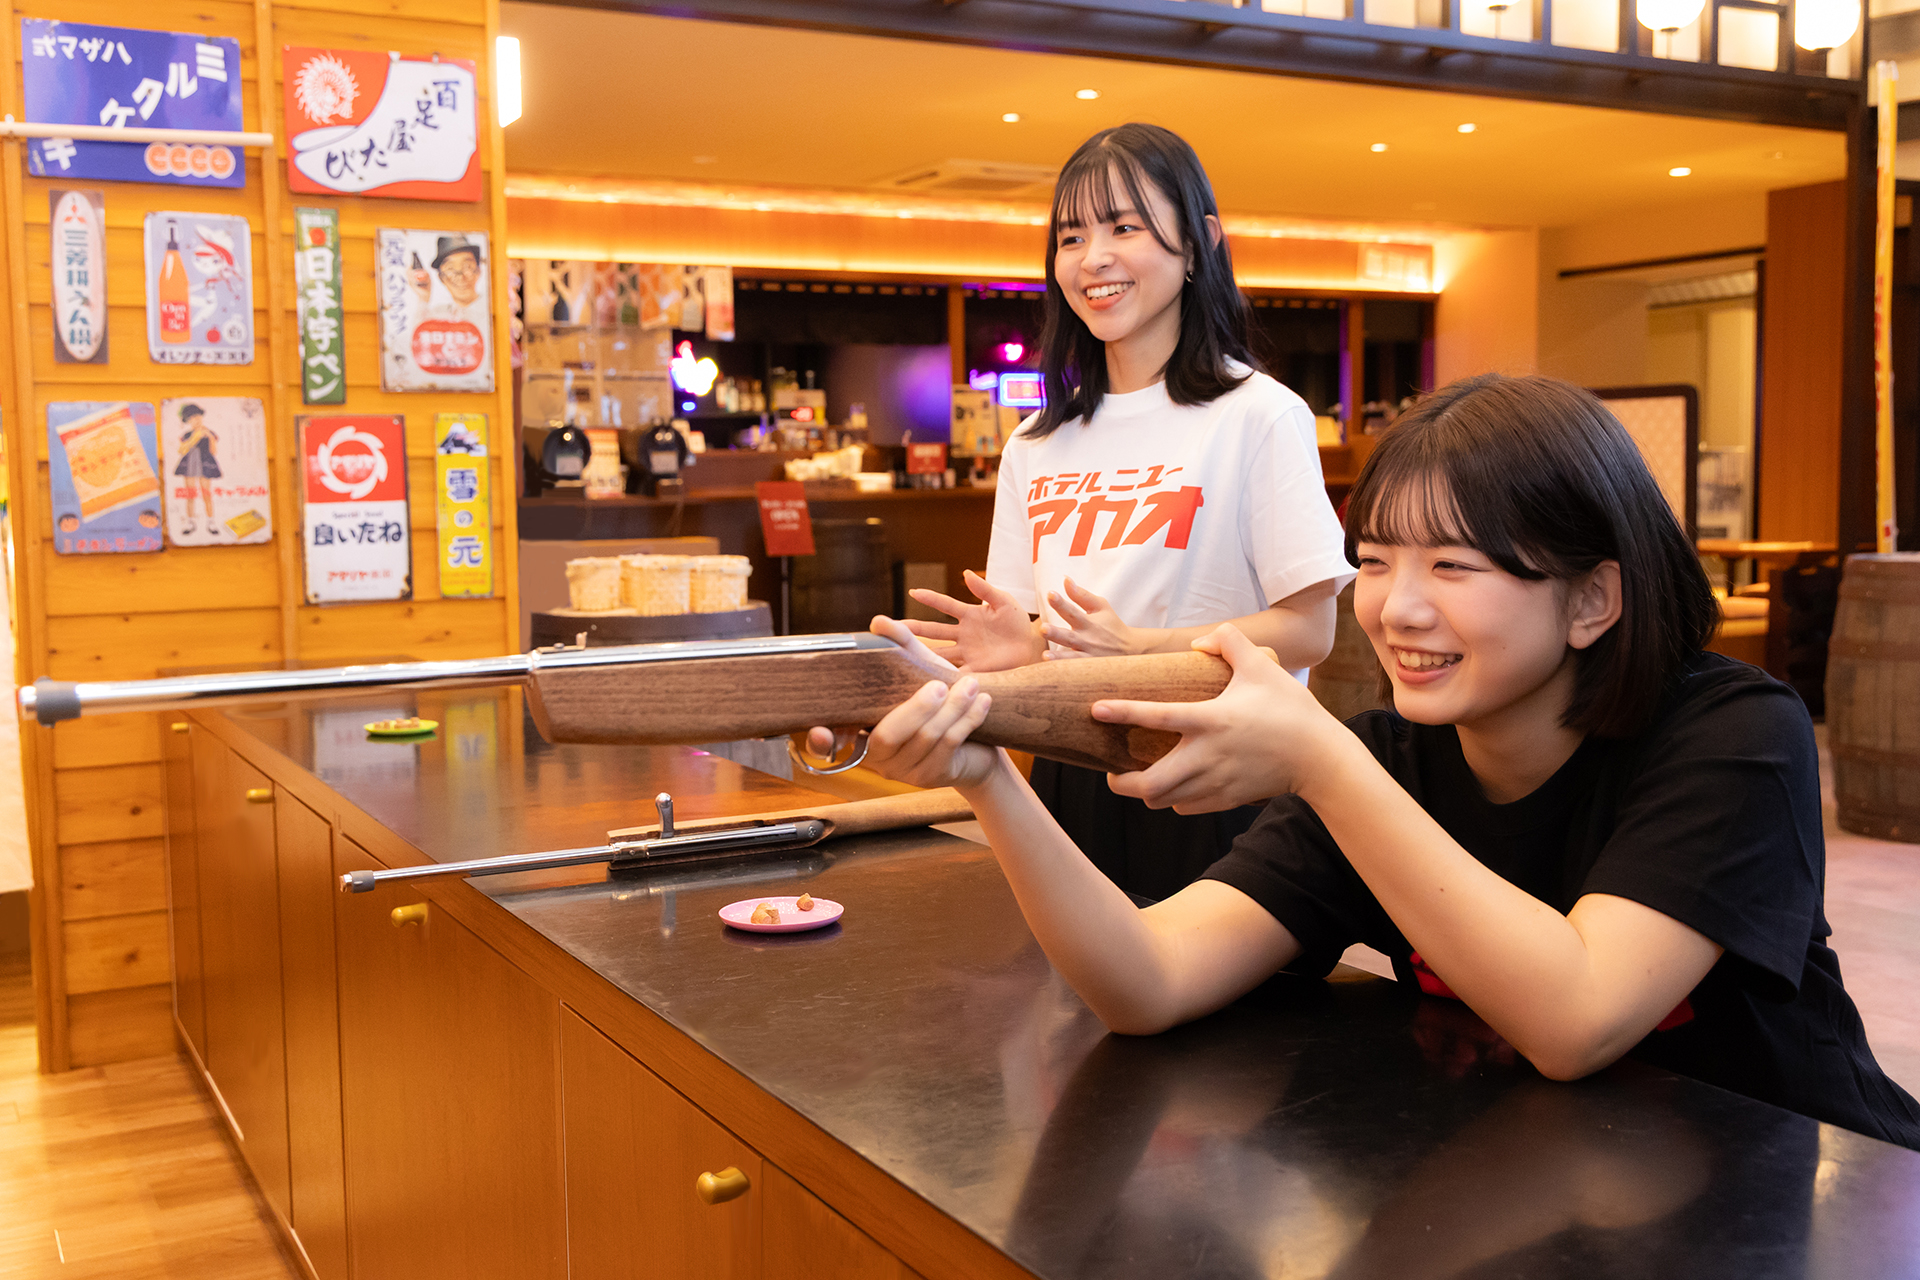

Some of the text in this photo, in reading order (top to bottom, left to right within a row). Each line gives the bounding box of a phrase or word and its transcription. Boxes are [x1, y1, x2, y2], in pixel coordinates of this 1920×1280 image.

[43, 43, 227, 170] ミルクケキ
[306, 248, 341, 400] 日本字ペン
[313, 521, 403, 545] 良いたね
[447, 468, 482, 567] 雪の元
[1028, 486, 1204, 564] アカオ
